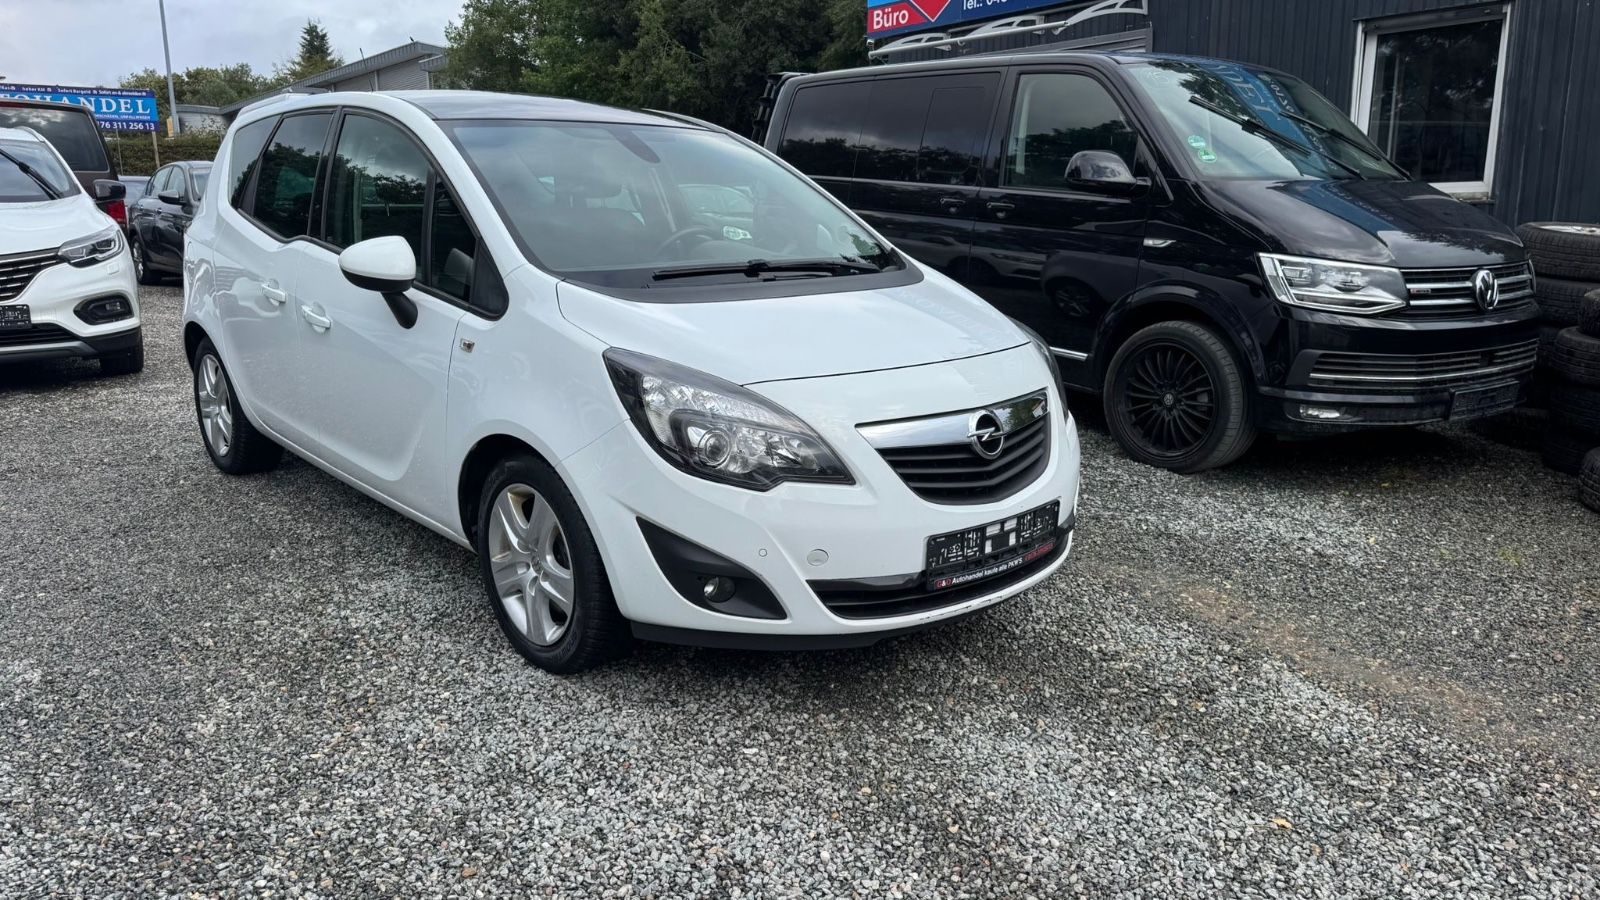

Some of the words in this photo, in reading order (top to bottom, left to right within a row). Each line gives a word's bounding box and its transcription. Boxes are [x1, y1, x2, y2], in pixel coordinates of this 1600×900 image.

[873, 8, 909, 29] Büro
[129, 122, 144, 130] 256
[952, 571, 984, 584] Autohandel
